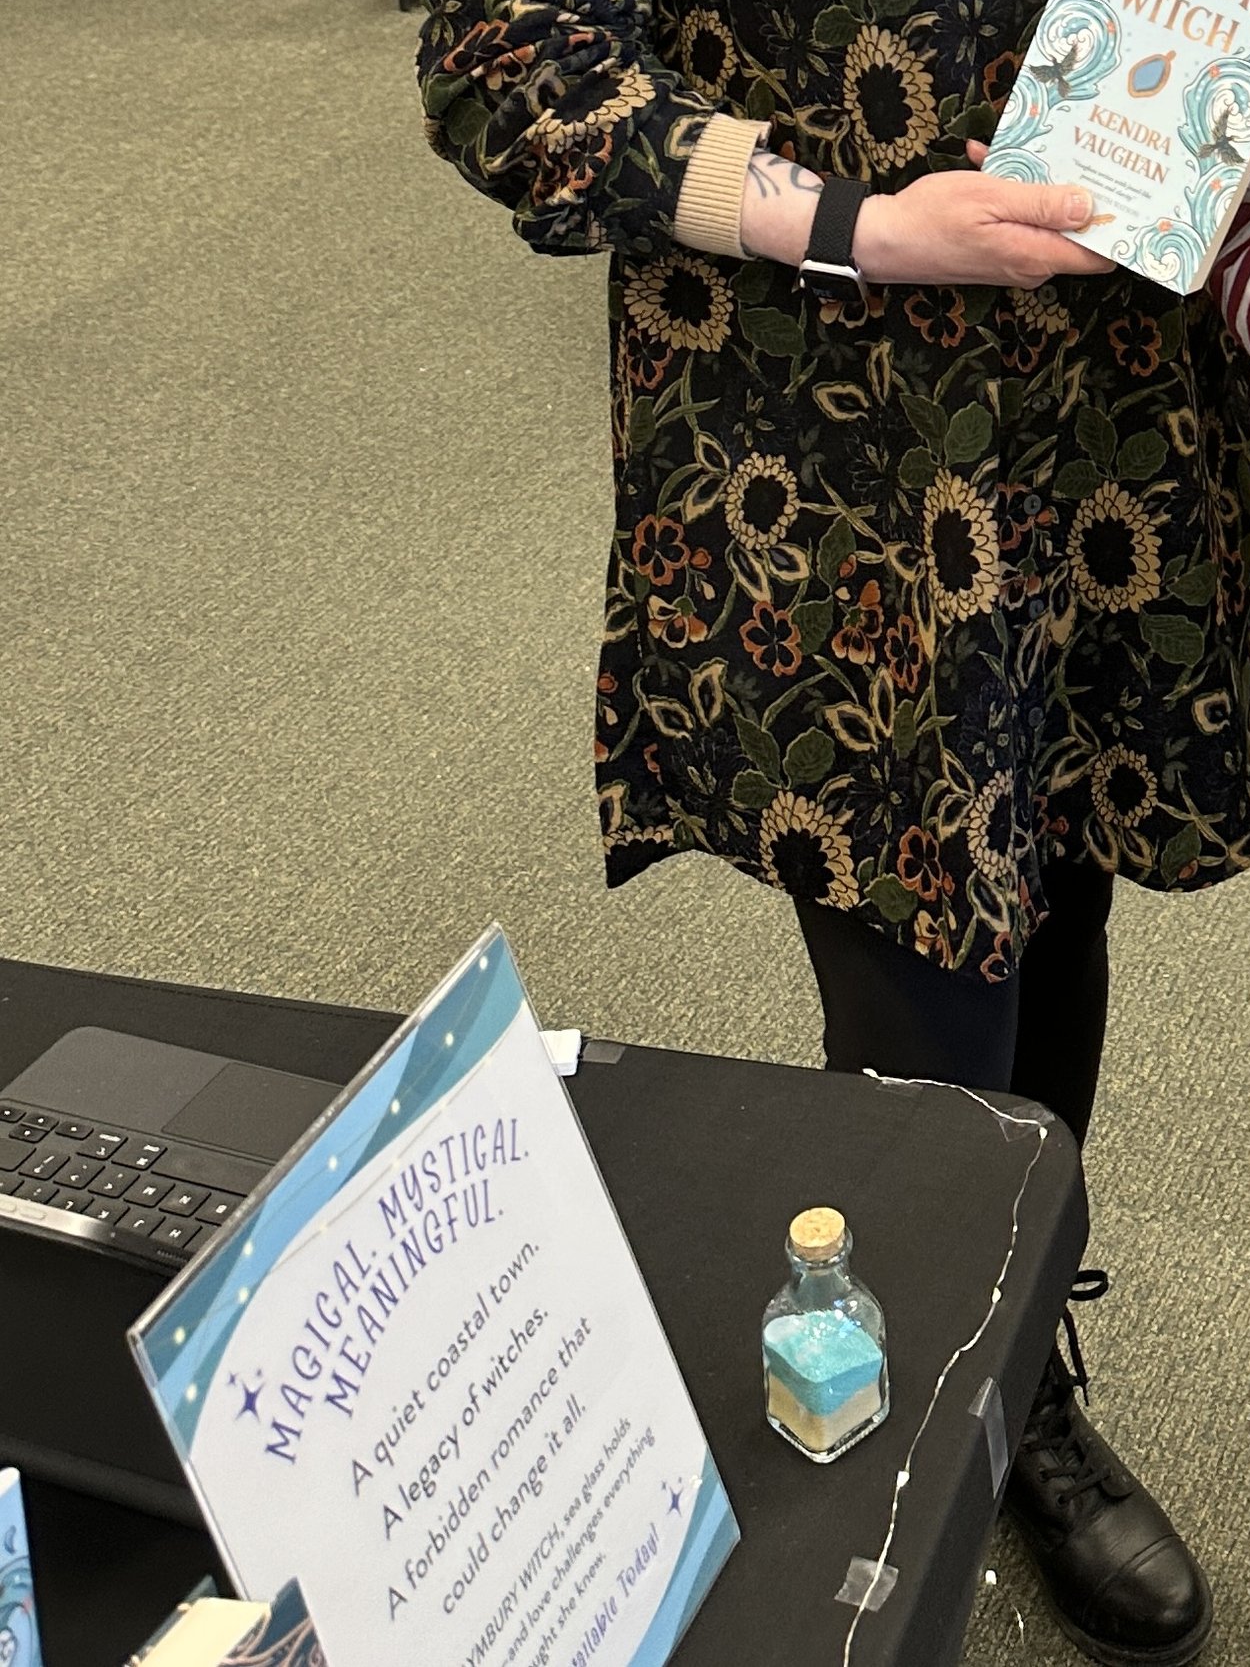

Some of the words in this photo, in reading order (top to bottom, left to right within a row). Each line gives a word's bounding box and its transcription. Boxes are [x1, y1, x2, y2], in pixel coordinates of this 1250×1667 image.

[1073, 125, 1170, 185] VAUGHAN
[1088, 104, 1172, 156] KENDRA
[265, 1240, 378, 1465] MAGICAL.
[377, 1118, 529, 1240] MYSTICAL.
[324, 1178, 504, 1418] MEANINGFUL.
[351, 1459, 374, 1497] A
[374, 1389, 426, 1468] quiet
[426, 1293, 491, 1392] coastal
[489, 1242, 540, 1306] town.
[382, 1504, 403, 1540] A
[399, 1425, 461, 1511] legacy
[461, 1382, 479, 1427] of
[481, 1309, 549, 1397] witches.
[387, 1586, 408, 1621] A
[404, 1470, 491, 1590] forbidden
[490, 1371, 559, 1471] romance
[557, 1316, 592, 1368] that
[442, 1532, 491, 1615] could
[491, 1452, 548, 1543] change
[544, 1426, 563, 1457] it
[562, 1393, 587, 1434] all.
[528, 1590, 551, 1628] love
[551, 1508, 604, 1591] challenges
[603, 1426, 656, 1508] everything
[461, 1581, 520, 1667] YMBURY
[518, 1522, 565, 1590] WITCH,
[563, 1496, 582, 1525] sea
[581, 1460, 606, 1504] glass
[602, 1417, 631, 1461] holds
[557, 1597, 577, 1628] she
[574, 1551, 607, 1600] knew.
[571, 1596, 618, 1667] ailable
[616, 1522, 661, 1598] Today!
